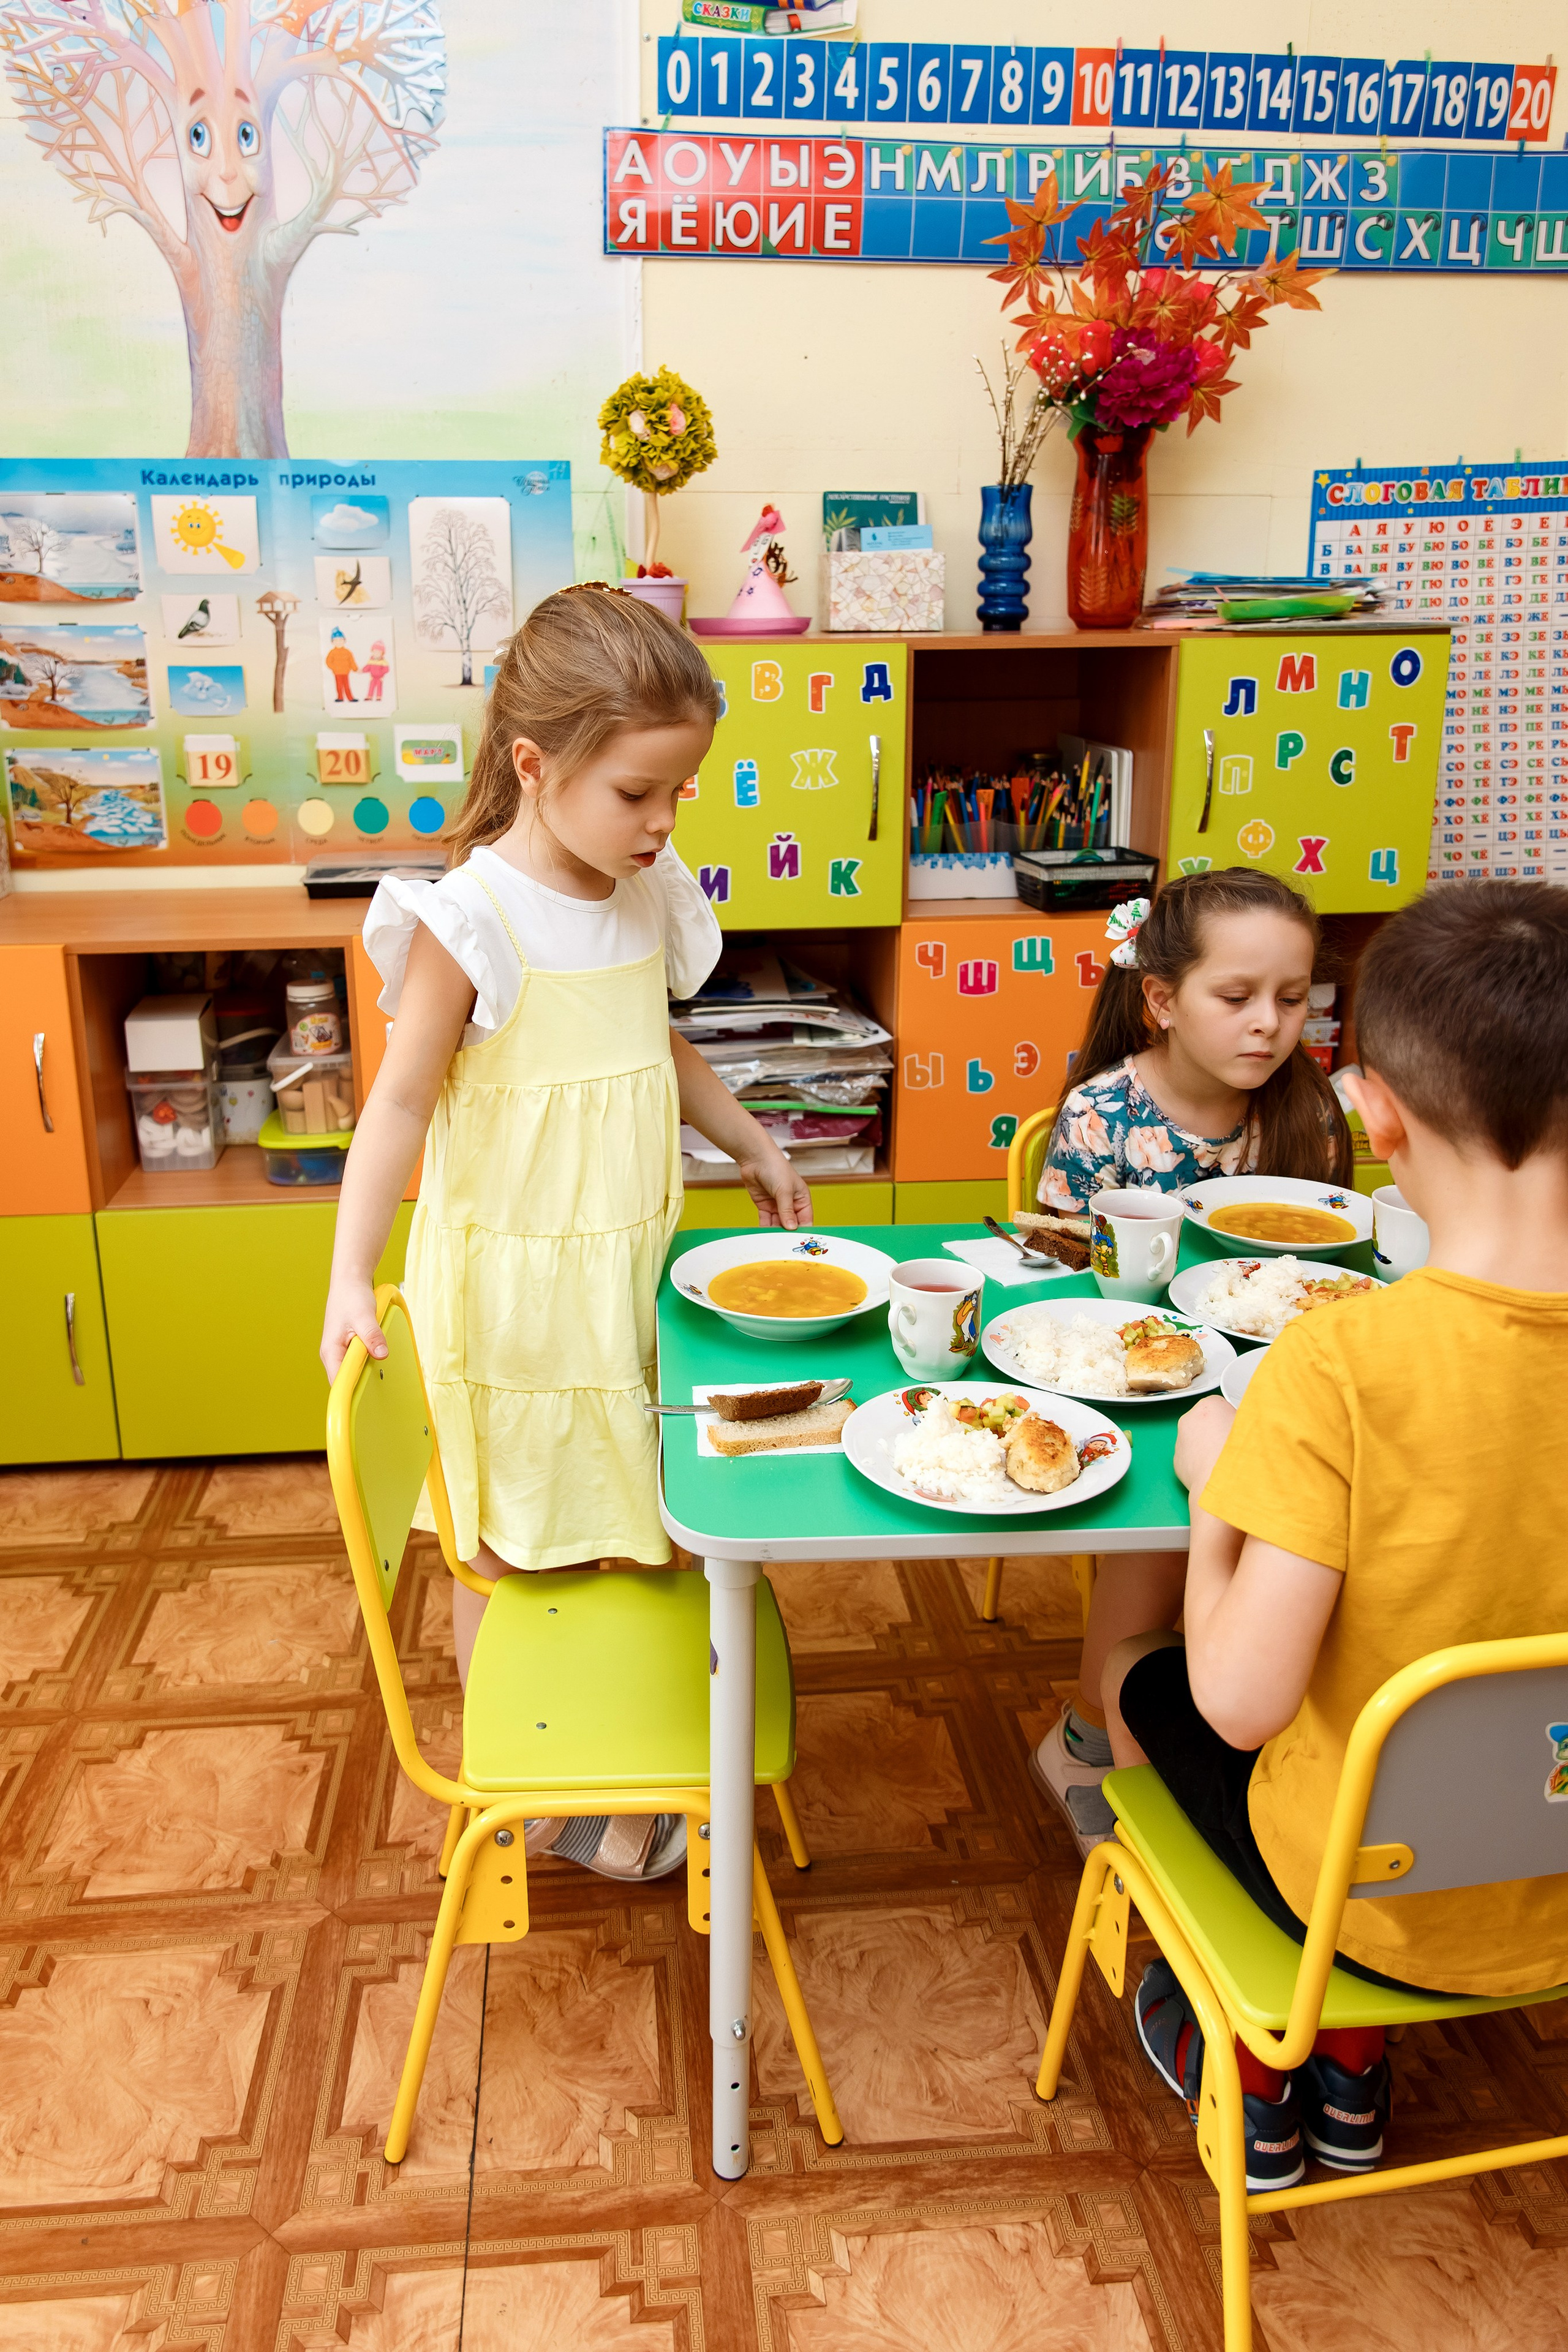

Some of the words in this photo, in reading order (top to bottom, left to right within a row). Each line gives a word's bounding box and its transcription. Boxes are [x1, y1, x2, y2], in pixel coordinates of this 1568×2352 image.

[692, 2, 752, 22] СКАЗКИ
[666, 50, 690, 105] 0
[710, 51, 728, 105] 1
[752, 53, 773, 107] 2
[793, 54, 815, 108] 3
[835, 56, 859, 109] 4
[876, 58, 898, 110] 5
[918, 59, 941, 111] 6
[960, 59, 983, 112] 7
[1000, 60, 1024, 113] 8
[1042, 61, 1064, 114] 9
[1079, 62, 1112, 115] 10
[1118, 63, 1153, 116] 11
[1165, 64, 1201, 118] 12
[1211, 66, 1246, 119] 13
[1256, 68, 1292, 121] 14
[1302, 70, 1336, 122] 15
[1344, 72, 1379, 124] 16
[1388, 74, 1424, 125] 17
[1431, 75, 1466, 126] 18
[1475, 77, 1509, 128] 19
[1510, 79, 1551, 130] 20
[612, 139, 654, 184] А
[663, 141, 707, 187] О
[718, 143, 755, 187] У
[770, 144, 809, 187] Ы
[824, 146, 855, 189] Э
[870, 148, 905, 191] Н
[916, 150, 962, 192] М
[970, 151, 1006, 193] Л
[1028, 153, 1056, 195] Р
[1074, 152, 1109, 197] Й
[1115, 156, 1143, 198] Б
[1166, 156, 1193, 198] В
[1257, 160, 1295, 206] Д
[1304, 159, 1346, 202] Ж
[1360, 160, 1387, 202] З
[617, 199, 646, 244] Я
[671, 195, 698, 245] Ё
[716, 202, 759, 247] Ю
[769, 202, 804, 249] И
[825, 205, 853, 249] Е
[1267, 215, 1291, 258] Т
[1302, 215, 1341, 258] Ш
[1355, 216, 1383, 259] С
[1400, 217, 1430, 260] Х
[1447, 218, 1480, 266] Ц
[1497, 220, 1524, 262] Ч
[141, 470, 259, 488] Календарь
[280, 473, 375, 489] природы
[1328, 480, 1464, 504] СЛОГОВАЯ
[1349, 524, 1361, 536] А
[1376, 523, 1387, 535] Я
[1403, 522, 1414, 535] У
[1428, 521, 1444, 533] Ю
[1458, 520, 1468, 532] О
[1483, 516, 1493, 532] Ё
[1511, 518, 1523, 530] Э
[1539, 516, 1550, 529] Е
[1322, 545, 1332, 557] Б
[1345, 545, 1363, 555] БА
[1371, 543, 1389, 554] БЯ
[1398, 543, 1415, 553] БУ
[1424, 541, 1445, 552] БЮ
[1452, 540, 1469, 551] БО
[1479, 538, 1494, 549] БЁ
[1506, 538, 1523, 548] БЭ
[1532, 537, 1549, 547] БЕ
[1321, 563, 1330, 575] В
[1344, 564, 1362, 575] ВА
[1371, 563, 1388, 573] ВЯ
[1396, 562, 1414, 571] ВУ
[1422, 561, 1444, 571] ВЮ
[1452, 560, 1469, 570] ВО
[1478, 557, 1494, 568] ВЁ
[1504, 557, 1522, 567] ВЭ
[1531, 556, 1547, 566] ВЕ
[1396, 581, 1413, 590] ГУ
[1422, 579, 1442, 589] ГЮ
[1451, 578, 1468, 588] ГО
[1479, 575, 1494, 587] ГЁ
[1506, 575, 1522, 585] ГЭ
[1532, 575, 1548, 584] ГЕ
[1395, 599, 1413, 609] ДУ
[1420, 597, 1442, 608] ДЮ
[1449, 597, 1469, 607] ДО
[1476, 594, 1494, 605] ДЁ
[1502, 594, 1523, 605] ДЭ
[1530, 593, 1548, 603] ДЕ
[1474, 612, 1494, 624] ЖЁ
[1501, 613, 1523, 623] ЖЭ
[1528, 612, 1548, 622] ЖЕ
[1276, 653, 1317, 693] М
[1390, 647, 1423, 687] О
[752, 660, 782, 702] В
[809, 672, 834, 713] Г
[861, 662, 893, 704] Д
[1223, 676, 1258, 716] Л
[1337, 670, 1371, 709] Н
[1446, 690, 1466, 699] МО
[1473, 687, 1491, 698] МЁ
[1499, 688, 1518, 697] МЭ
[1526, 687, 1544, 696] МЕ
[1446, 707, 1464, 717] НО
[1472, 704, 1489, 715] НЁ
[1499, 705, 1518, 714] НЭ
[1526, 704, 1543, 713] НЕ
[1219, 755, 1253, 794] П
[1275, 730, 1306, 770] Р
[1329, 747, 1355, 786] С
[1389, 723, 1417, 763] Т
[1447, 743, 1464, 753] РО
[1475, 741, 1490, 752] РЁ
[1501, 742, 1518, 751] РЭ
[1528, 741, 1544, 750] РЕ
[197, 753, 232, 780] 19
[326, 750, 361, 777] 20
[734, 759, 759, 807] Ё
[790, 748, 839, 790] Ж
[1446, 779, 1463, 789] ТО
[1474, 776, 1490, 788] ТЁ
[1500, 777, 1518, 786] ТЭ
[1527, 776, 1543, 785] ТЕ
[1444, 815, 1463, 825] ХО
[1472, 813, 1489, 823] ХЁ
[1499, 813, 1518, 823] ХЭ
[1526, 812, 1542, 821] ХЕ
[698, 864, 731, 903] И
[767, 832, 801, 880] Й
[829, 858, 862, 897] К
[1238, 820, 1275, 858] Ф
[1293, 836, 1329, 874] Х
[1369, 848, 1400, 886] Ц
[916, 941, 946, 978] Ч
[957, 959, 998, 997] Ш
[1012, 936, 1054, 976] Щ
[1075, 951, 1105, 988] Ъ
[904, 1052, 944, 1090] Ы
[967, 1058, 995, 1094] Ь
[1014, 1041, 1041, 1078] Э
[988, 1113, 1019, 1148] Я
